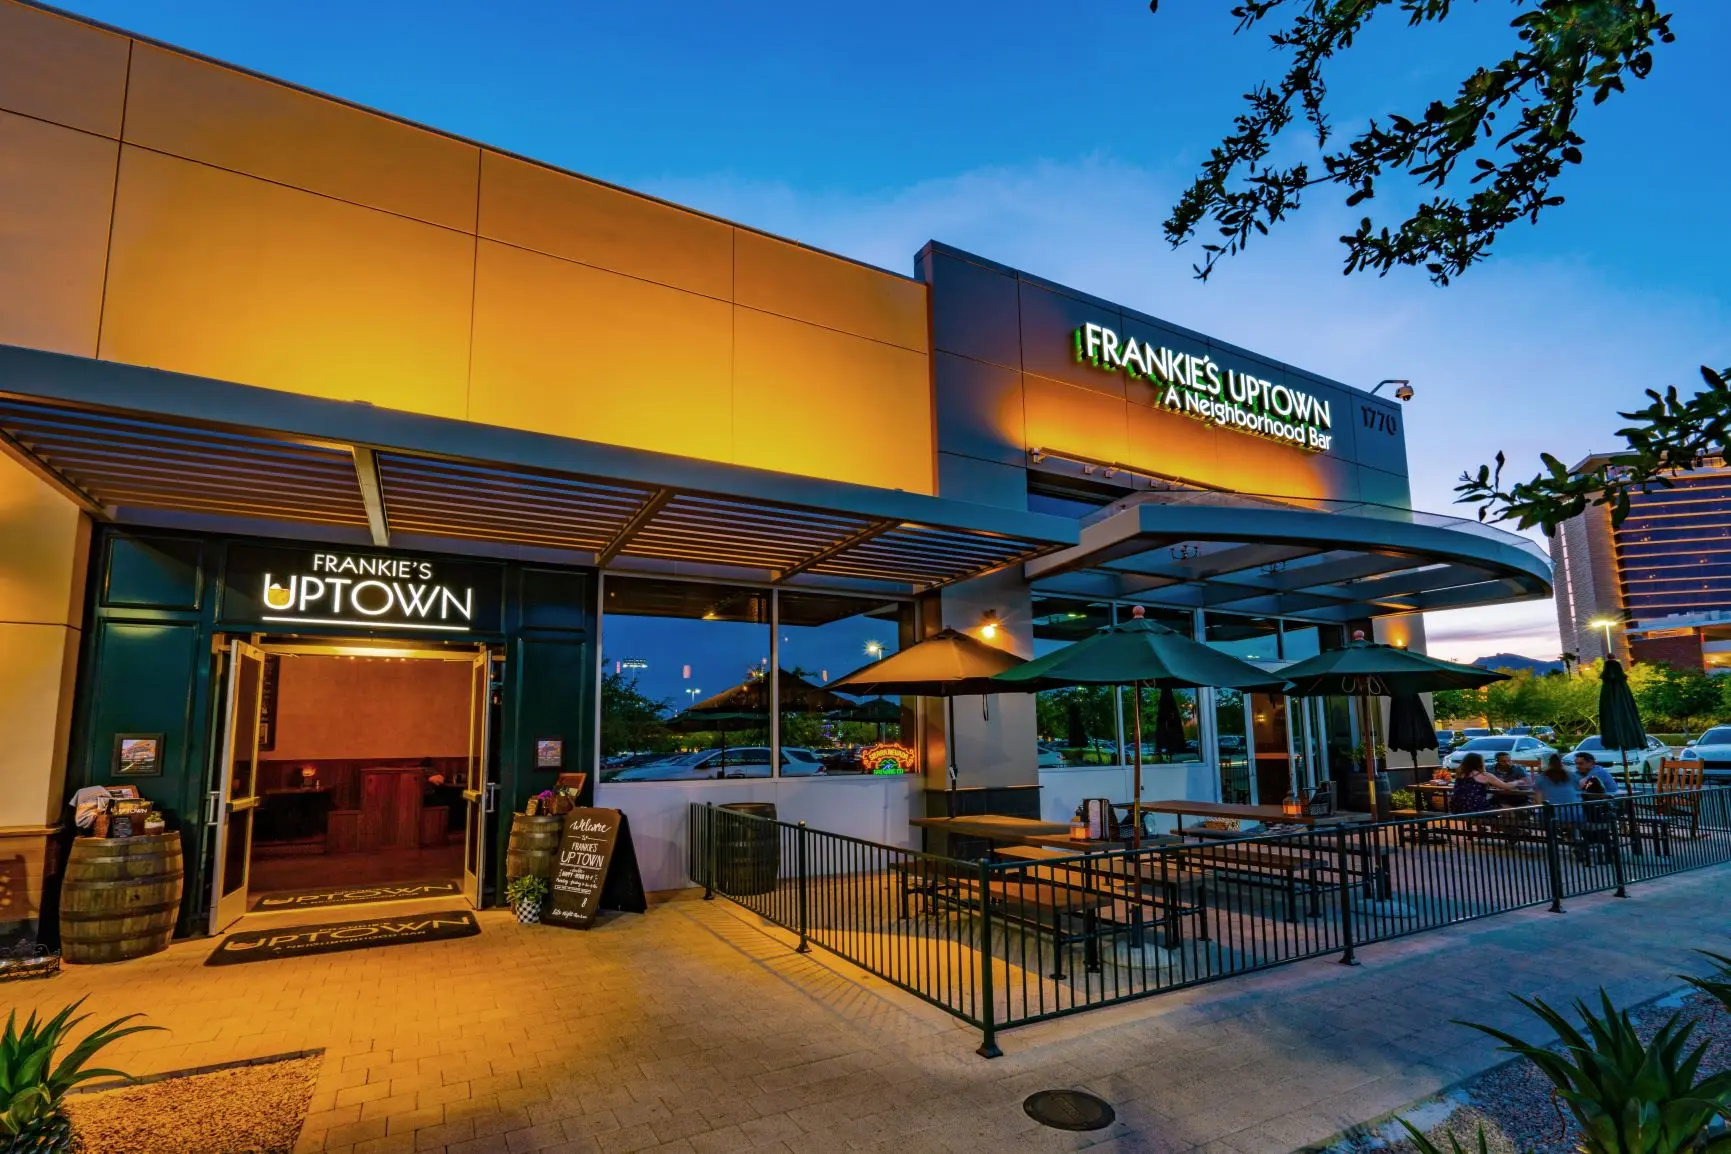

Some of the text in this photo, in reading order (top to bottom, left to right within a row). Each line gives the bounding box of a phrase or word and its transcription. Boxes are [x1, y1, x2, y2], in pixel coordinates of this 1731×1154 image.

[1084, 321, 1332, 429] FRANKIE'S UPTOWN
[1164, 385, 1332, 450] A Neighborhood Bar
[1361, 405, 1397, 436] 1770
[313, 553, 432, 580] FRANKIE'S
[263, 573, 472, 620] UPTOWN
[561, 851, 604, 867] UPTOWN
[262, 884, 453, 905] UPTOWN
[224, 916, 470, 951] UPTOWN
